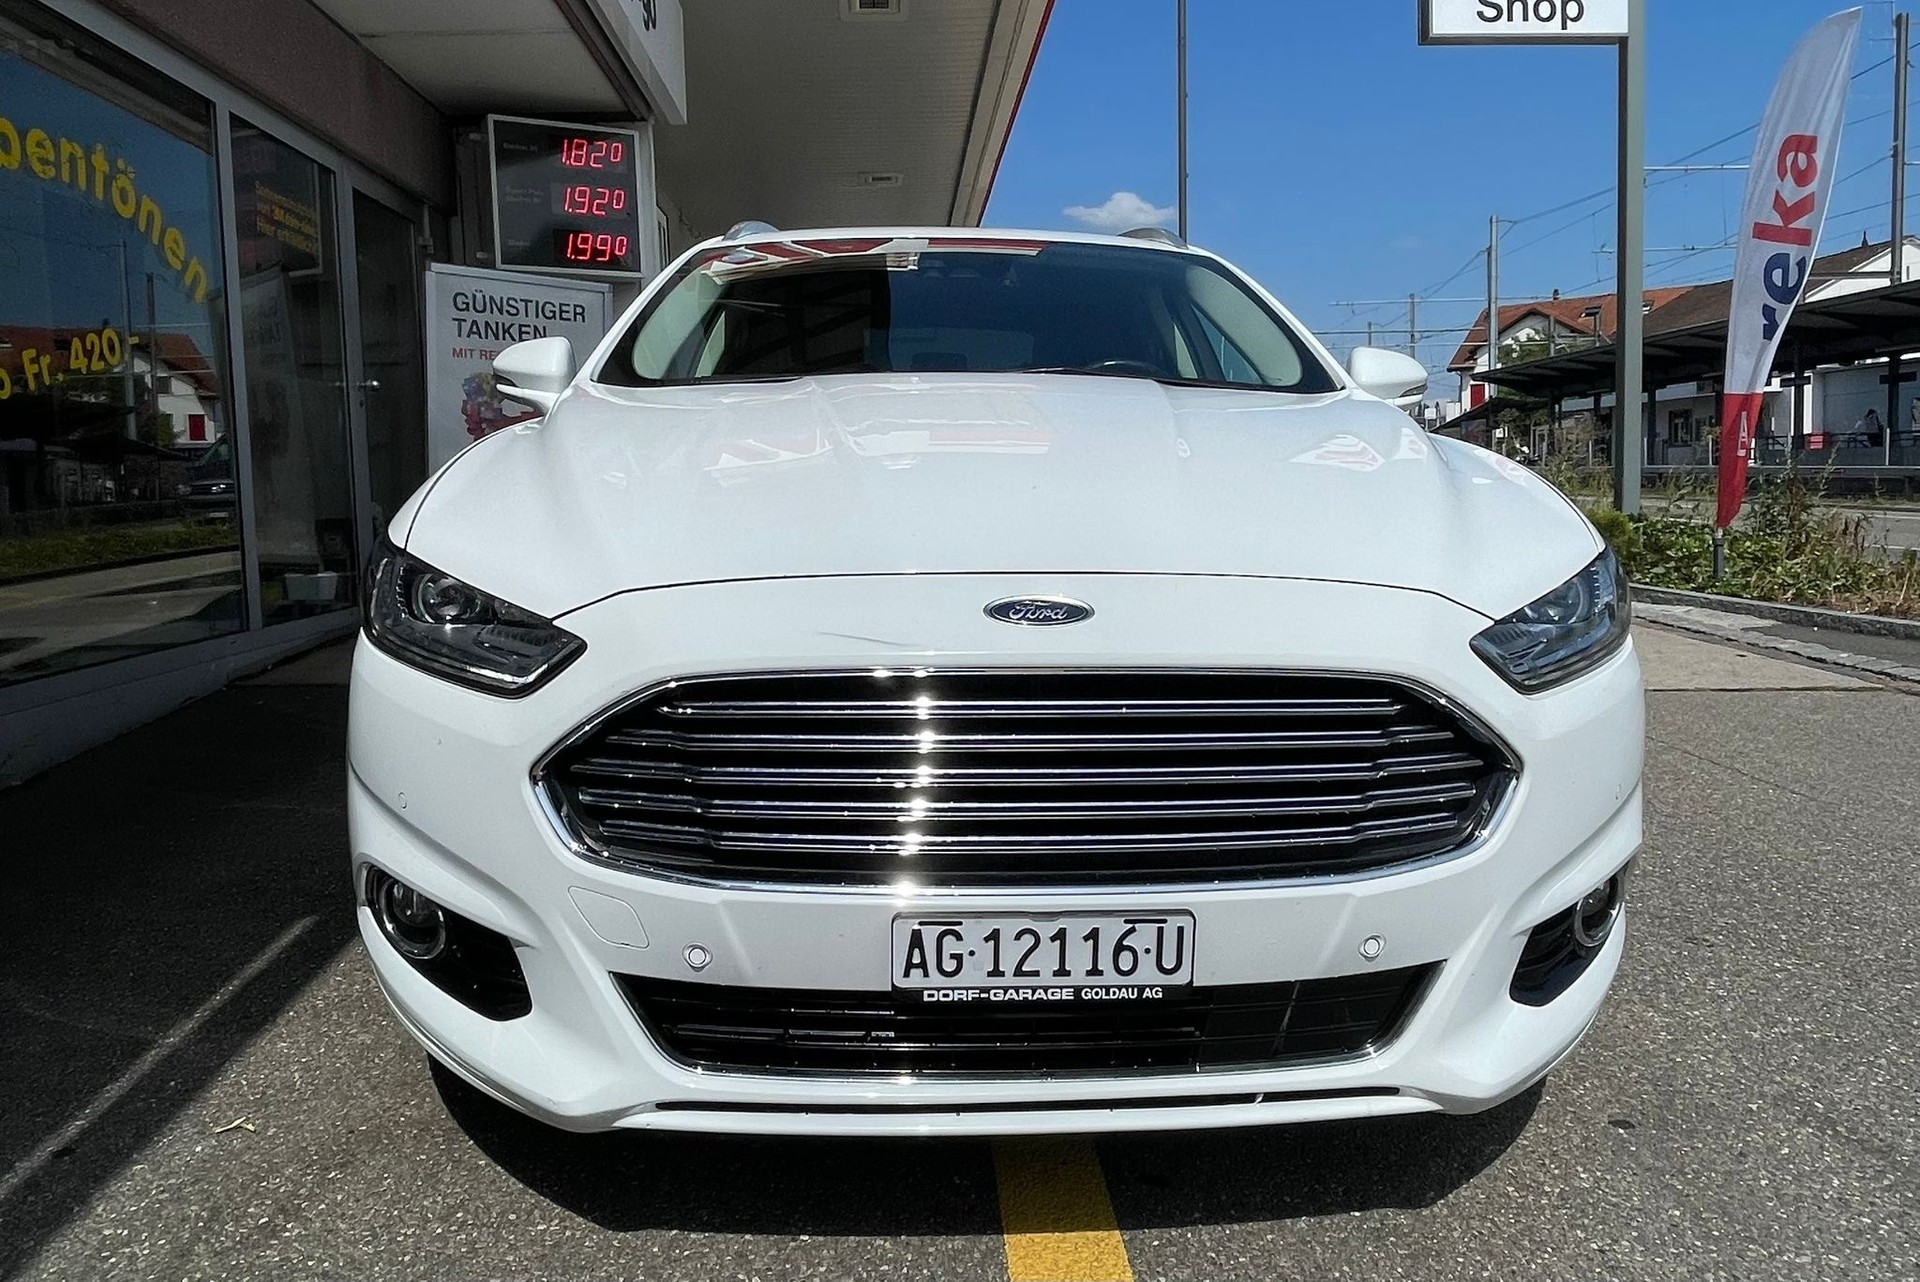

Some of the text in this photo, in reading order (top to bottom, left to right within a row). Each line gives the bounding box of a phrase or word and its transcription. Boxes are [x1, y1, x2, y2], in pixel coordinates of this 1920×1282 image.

[452, 289, 586, 323] GÜNSTIGER
[452, 317, 547, 342] TANKEN
[452, 347, 478, 359] MIT
[1009, 602, 1068, 619] Ford
[923, 988, 1163, 1002] DORF-GARAGE GOLDAU AG
